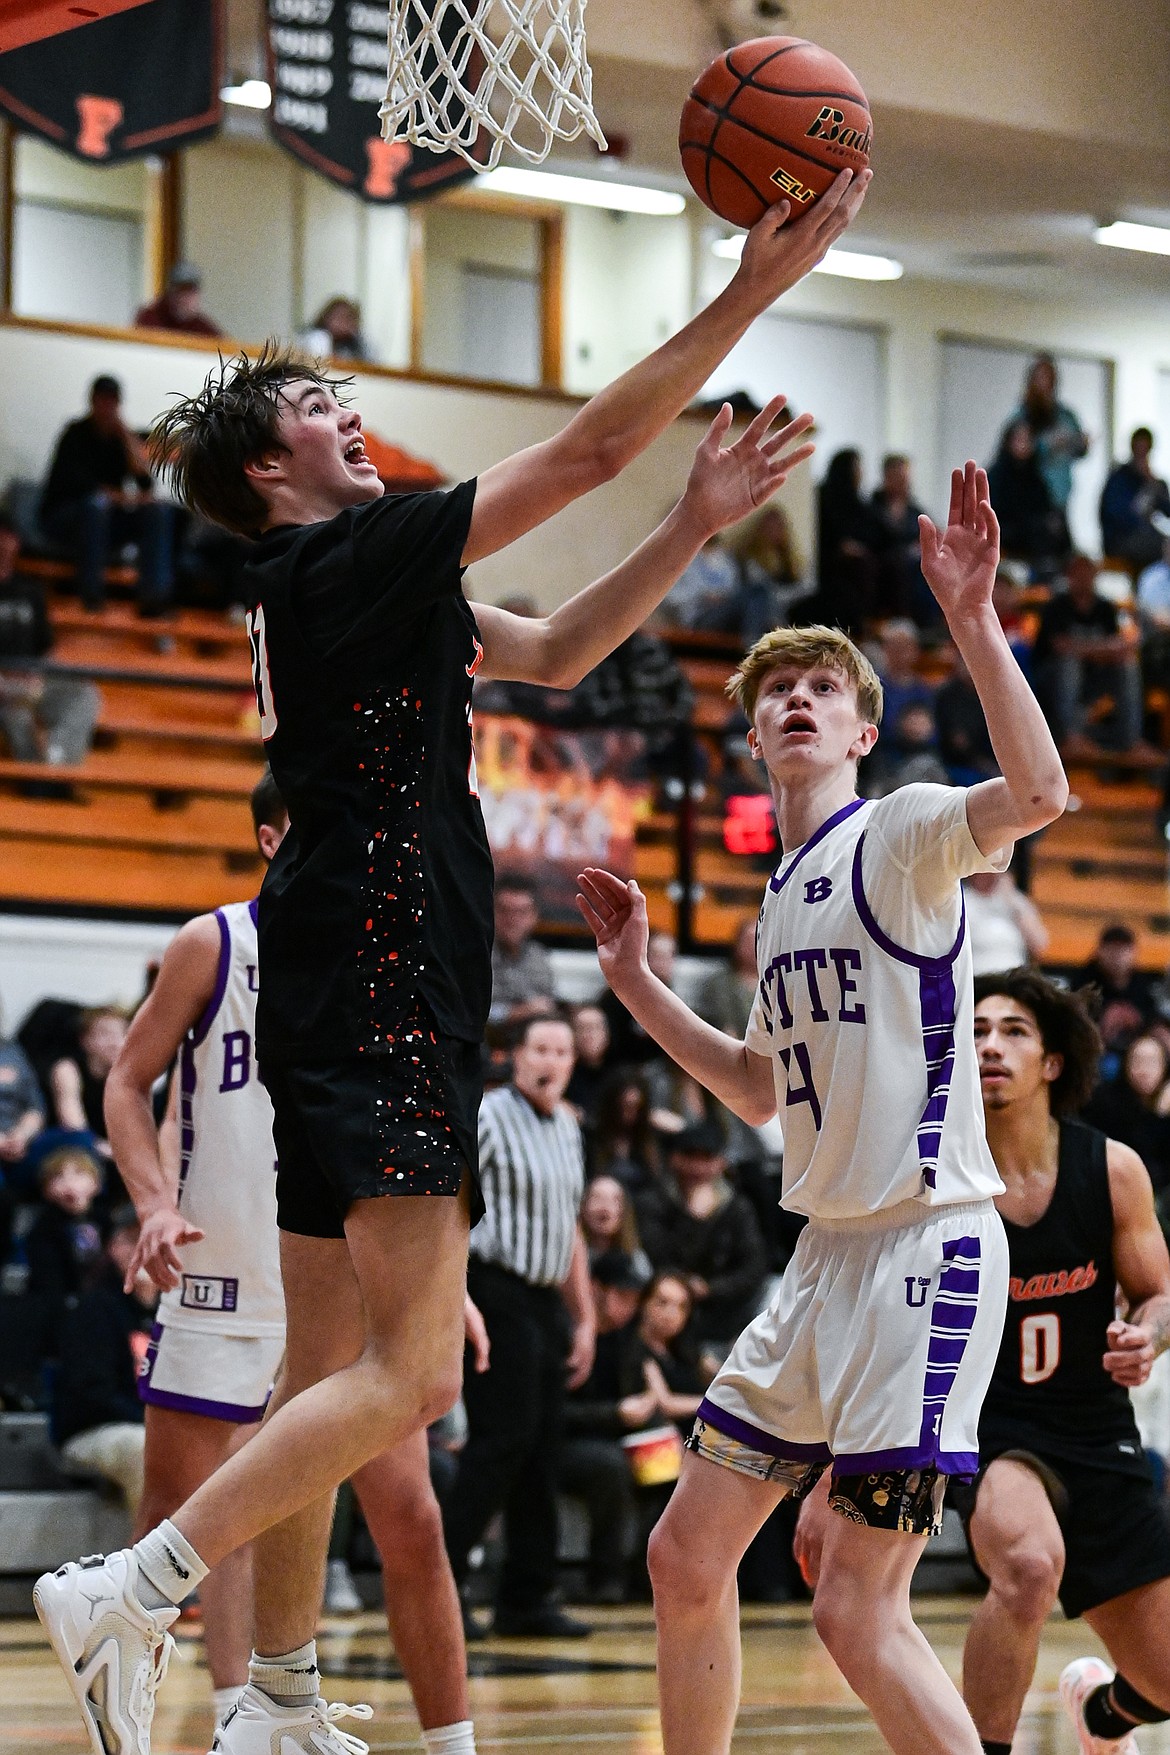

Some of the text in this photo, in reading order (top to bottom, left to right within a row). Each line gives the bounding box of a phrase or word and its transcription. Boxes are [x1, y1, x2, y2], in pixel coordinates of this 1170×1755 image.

[769, 167, 817, 203] ELI
[803, 876, 833, 904] B
[219, 1030, 264, 1094] B
[778, 1041, 822, 1131] 4
[1020, 1312, 1060, 1385] 0
